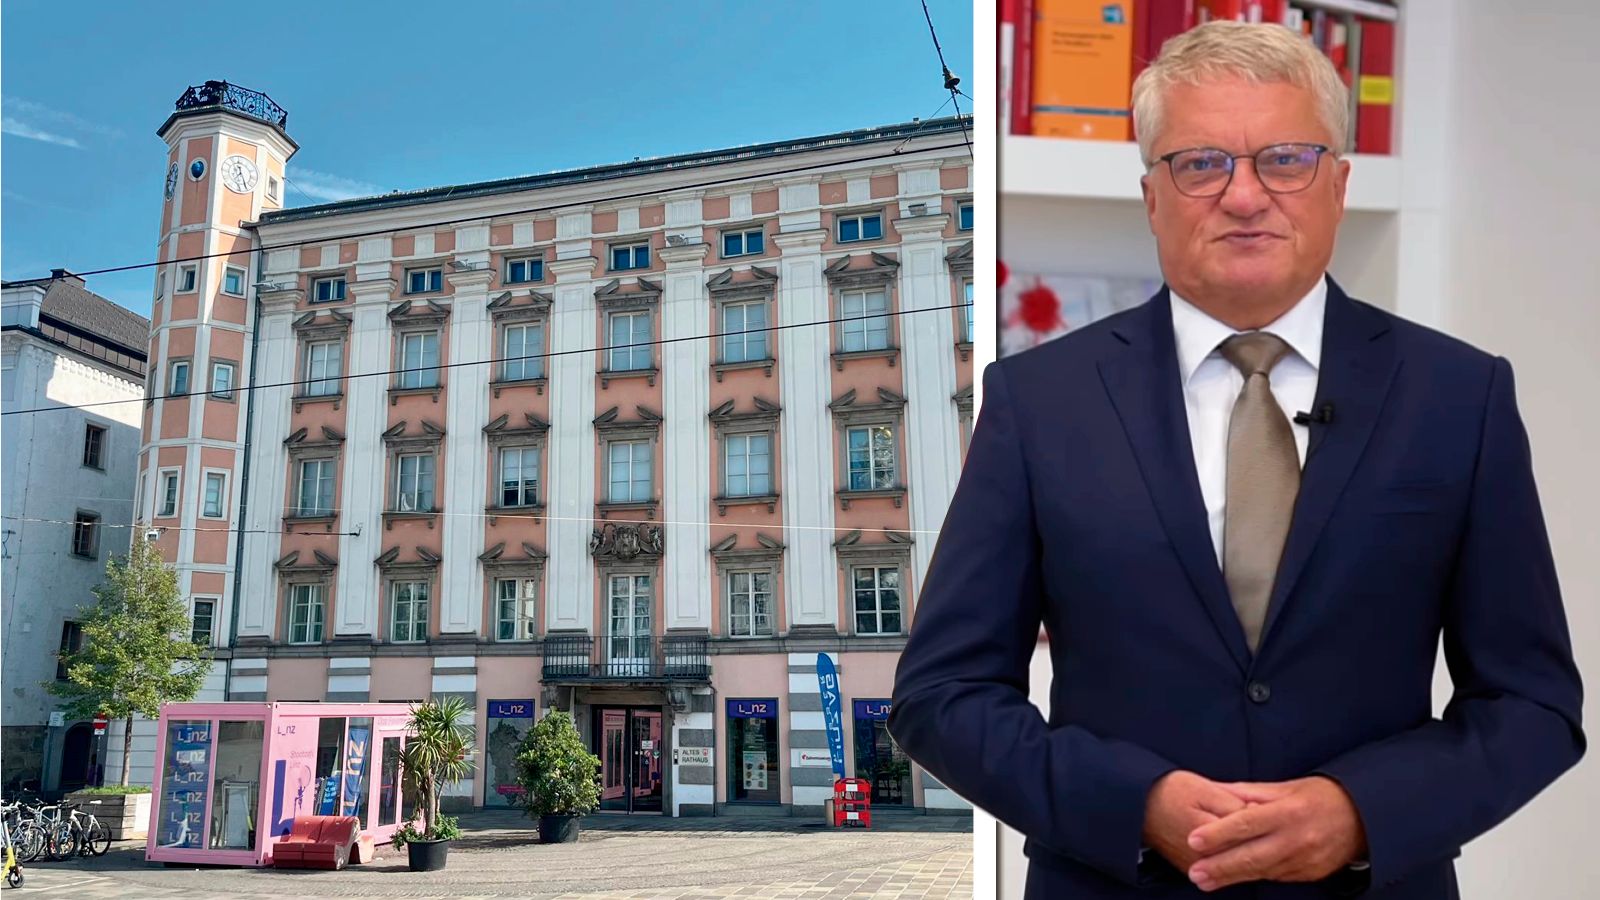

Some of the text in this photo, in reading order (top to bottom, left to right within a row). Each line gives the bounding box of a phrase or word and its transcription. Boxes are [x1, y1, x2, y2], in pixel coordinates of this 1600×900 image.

[498, 704, 524, 715] L_nz
[738, 704, 767, 714] L_nz
[277, 725, 296, 736] L_nz
[174, 771, 204, 783] L_nz
[172, 791, 202, 804] L_nz
